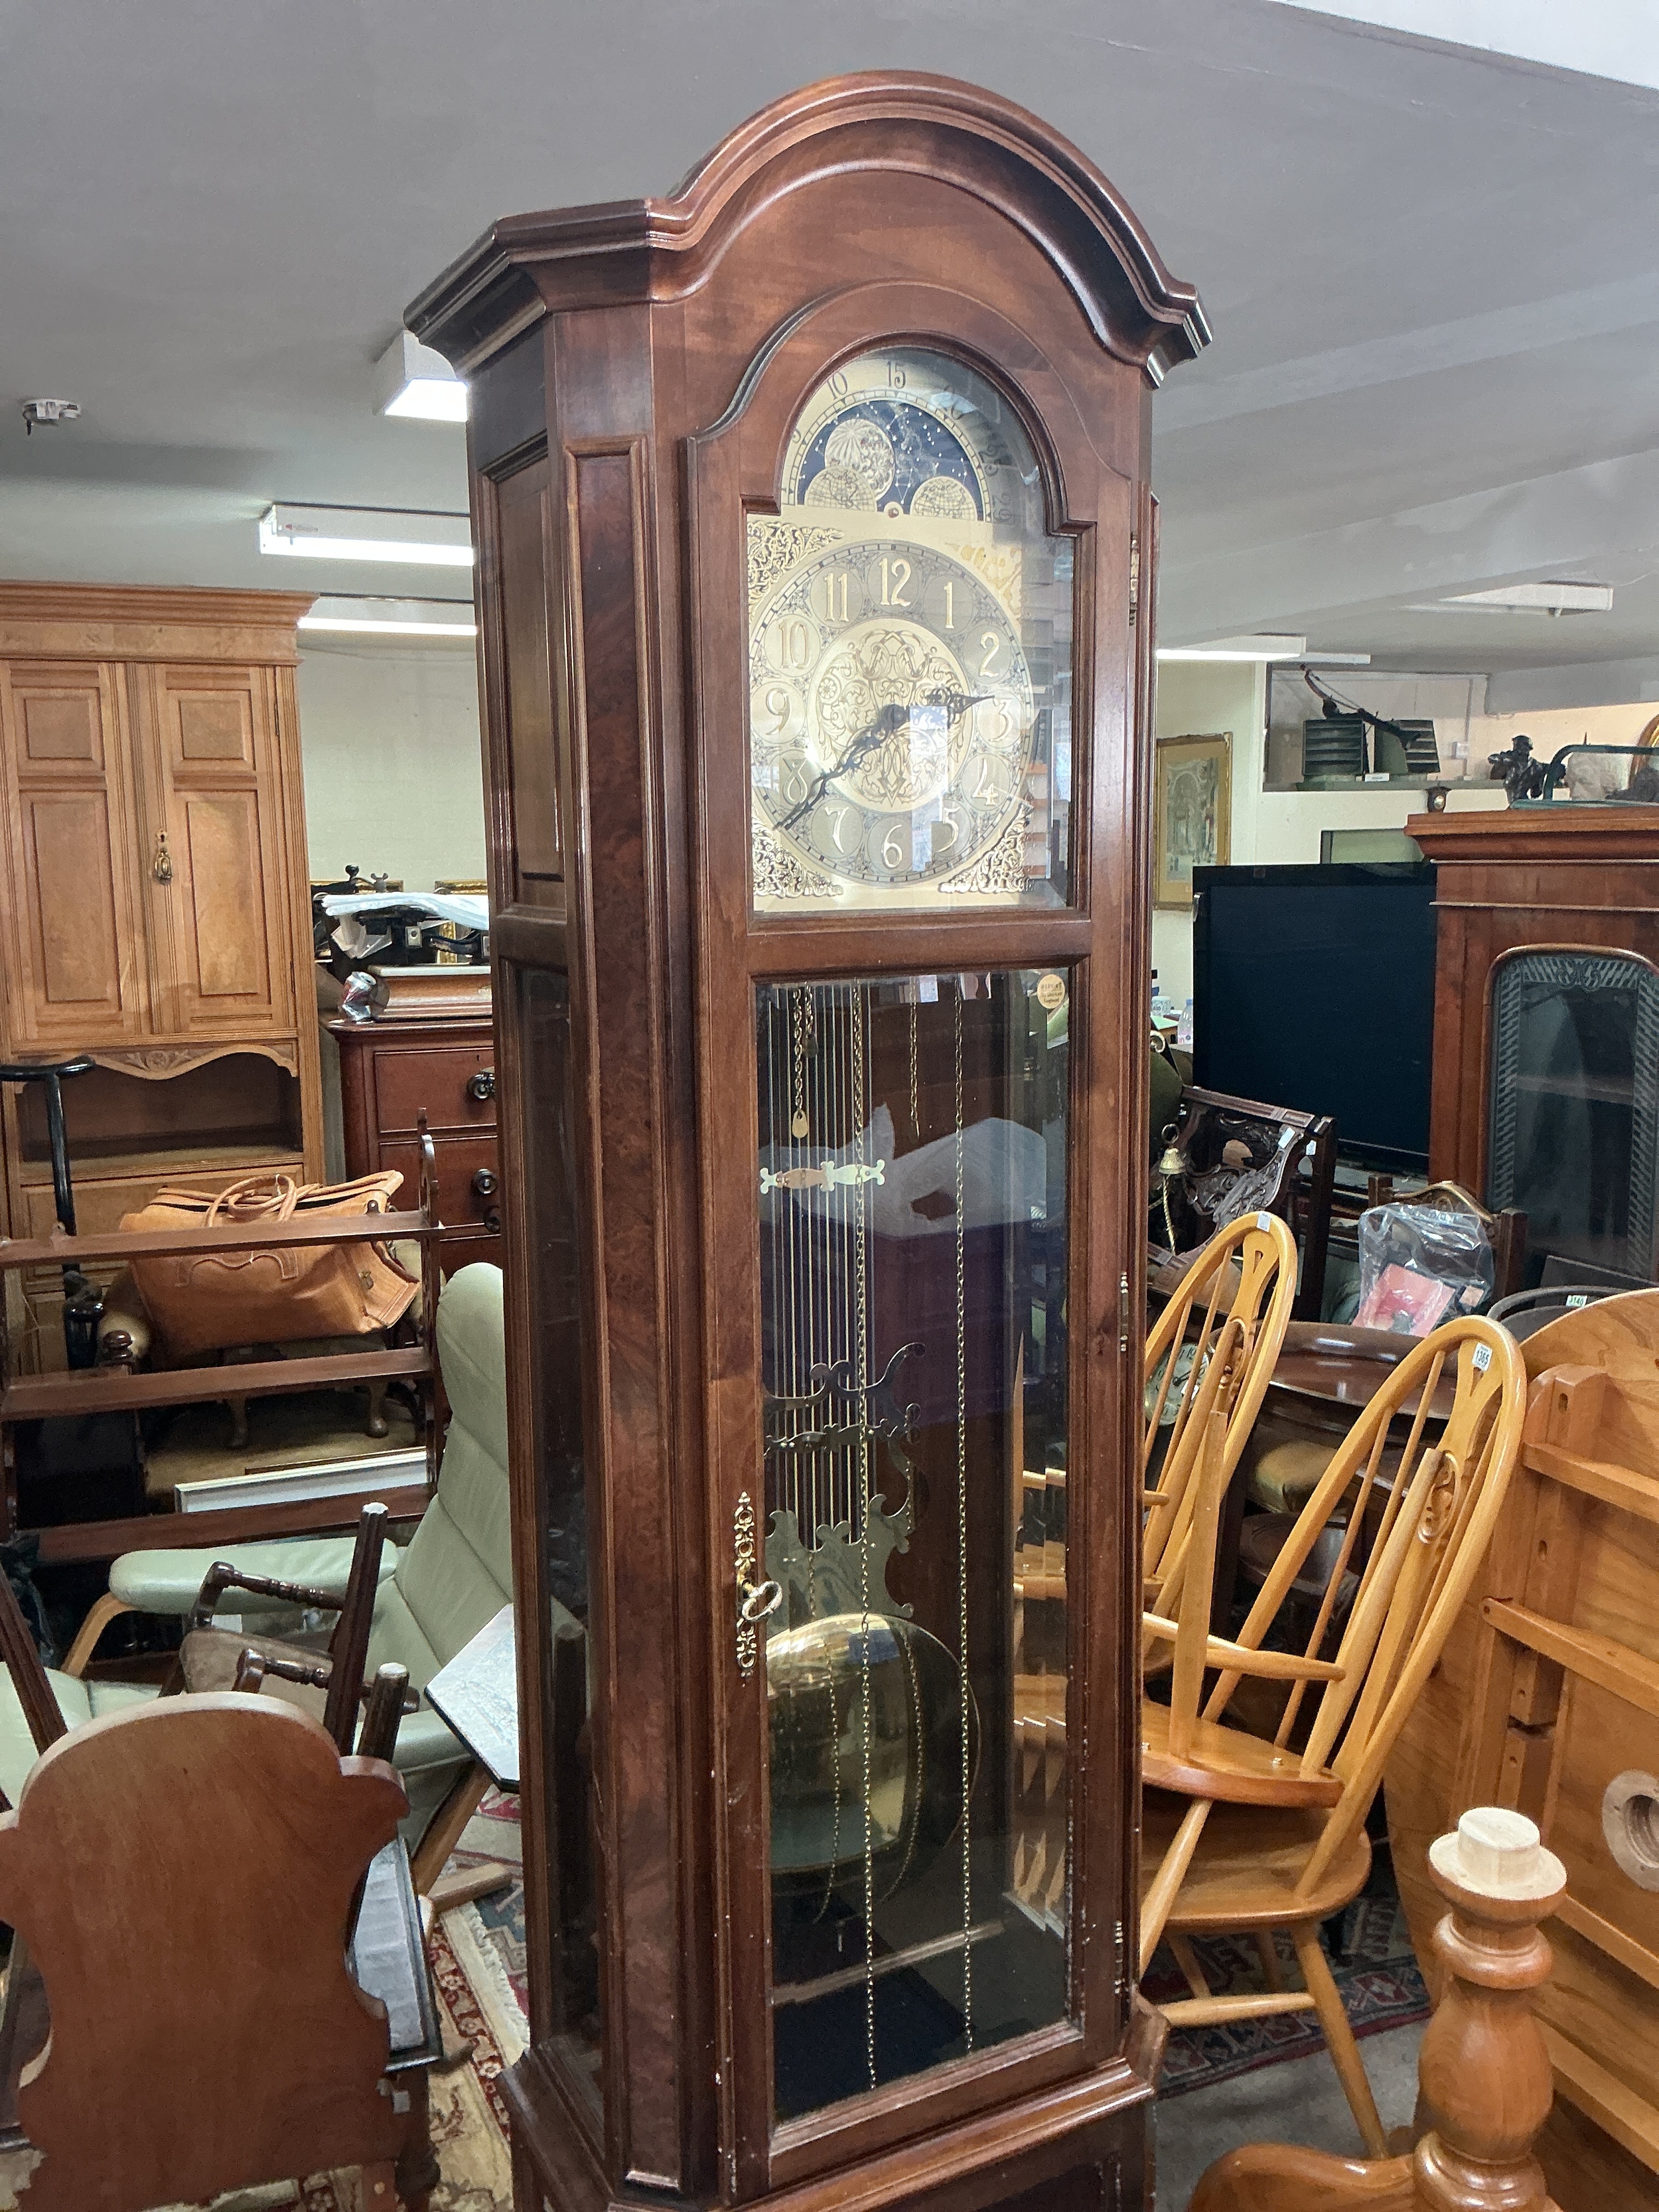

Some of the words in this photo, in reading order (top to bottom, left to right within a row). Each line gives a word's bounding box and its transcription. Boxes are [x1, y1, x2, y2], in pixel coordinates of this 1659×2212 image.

[887, 361, 906, 390] 15
[823, 571, 849, 623] 11
[878, 557, 912, 607] 12
[943, 581, 955, 629] 1
[778, 619, 810, 670] 10
[979, 631, 1000, 678] 2
[765, 688, 792, 736] 9
[990, 694, 1014, 742] 3
[972, 758, 999, 806] 4
[824, 806, 850, 853] 7
[881, 824, 903, 869] 6
[936, 806, 960, 853] 5
[1476, 1350, 1490, 1366] 1365
